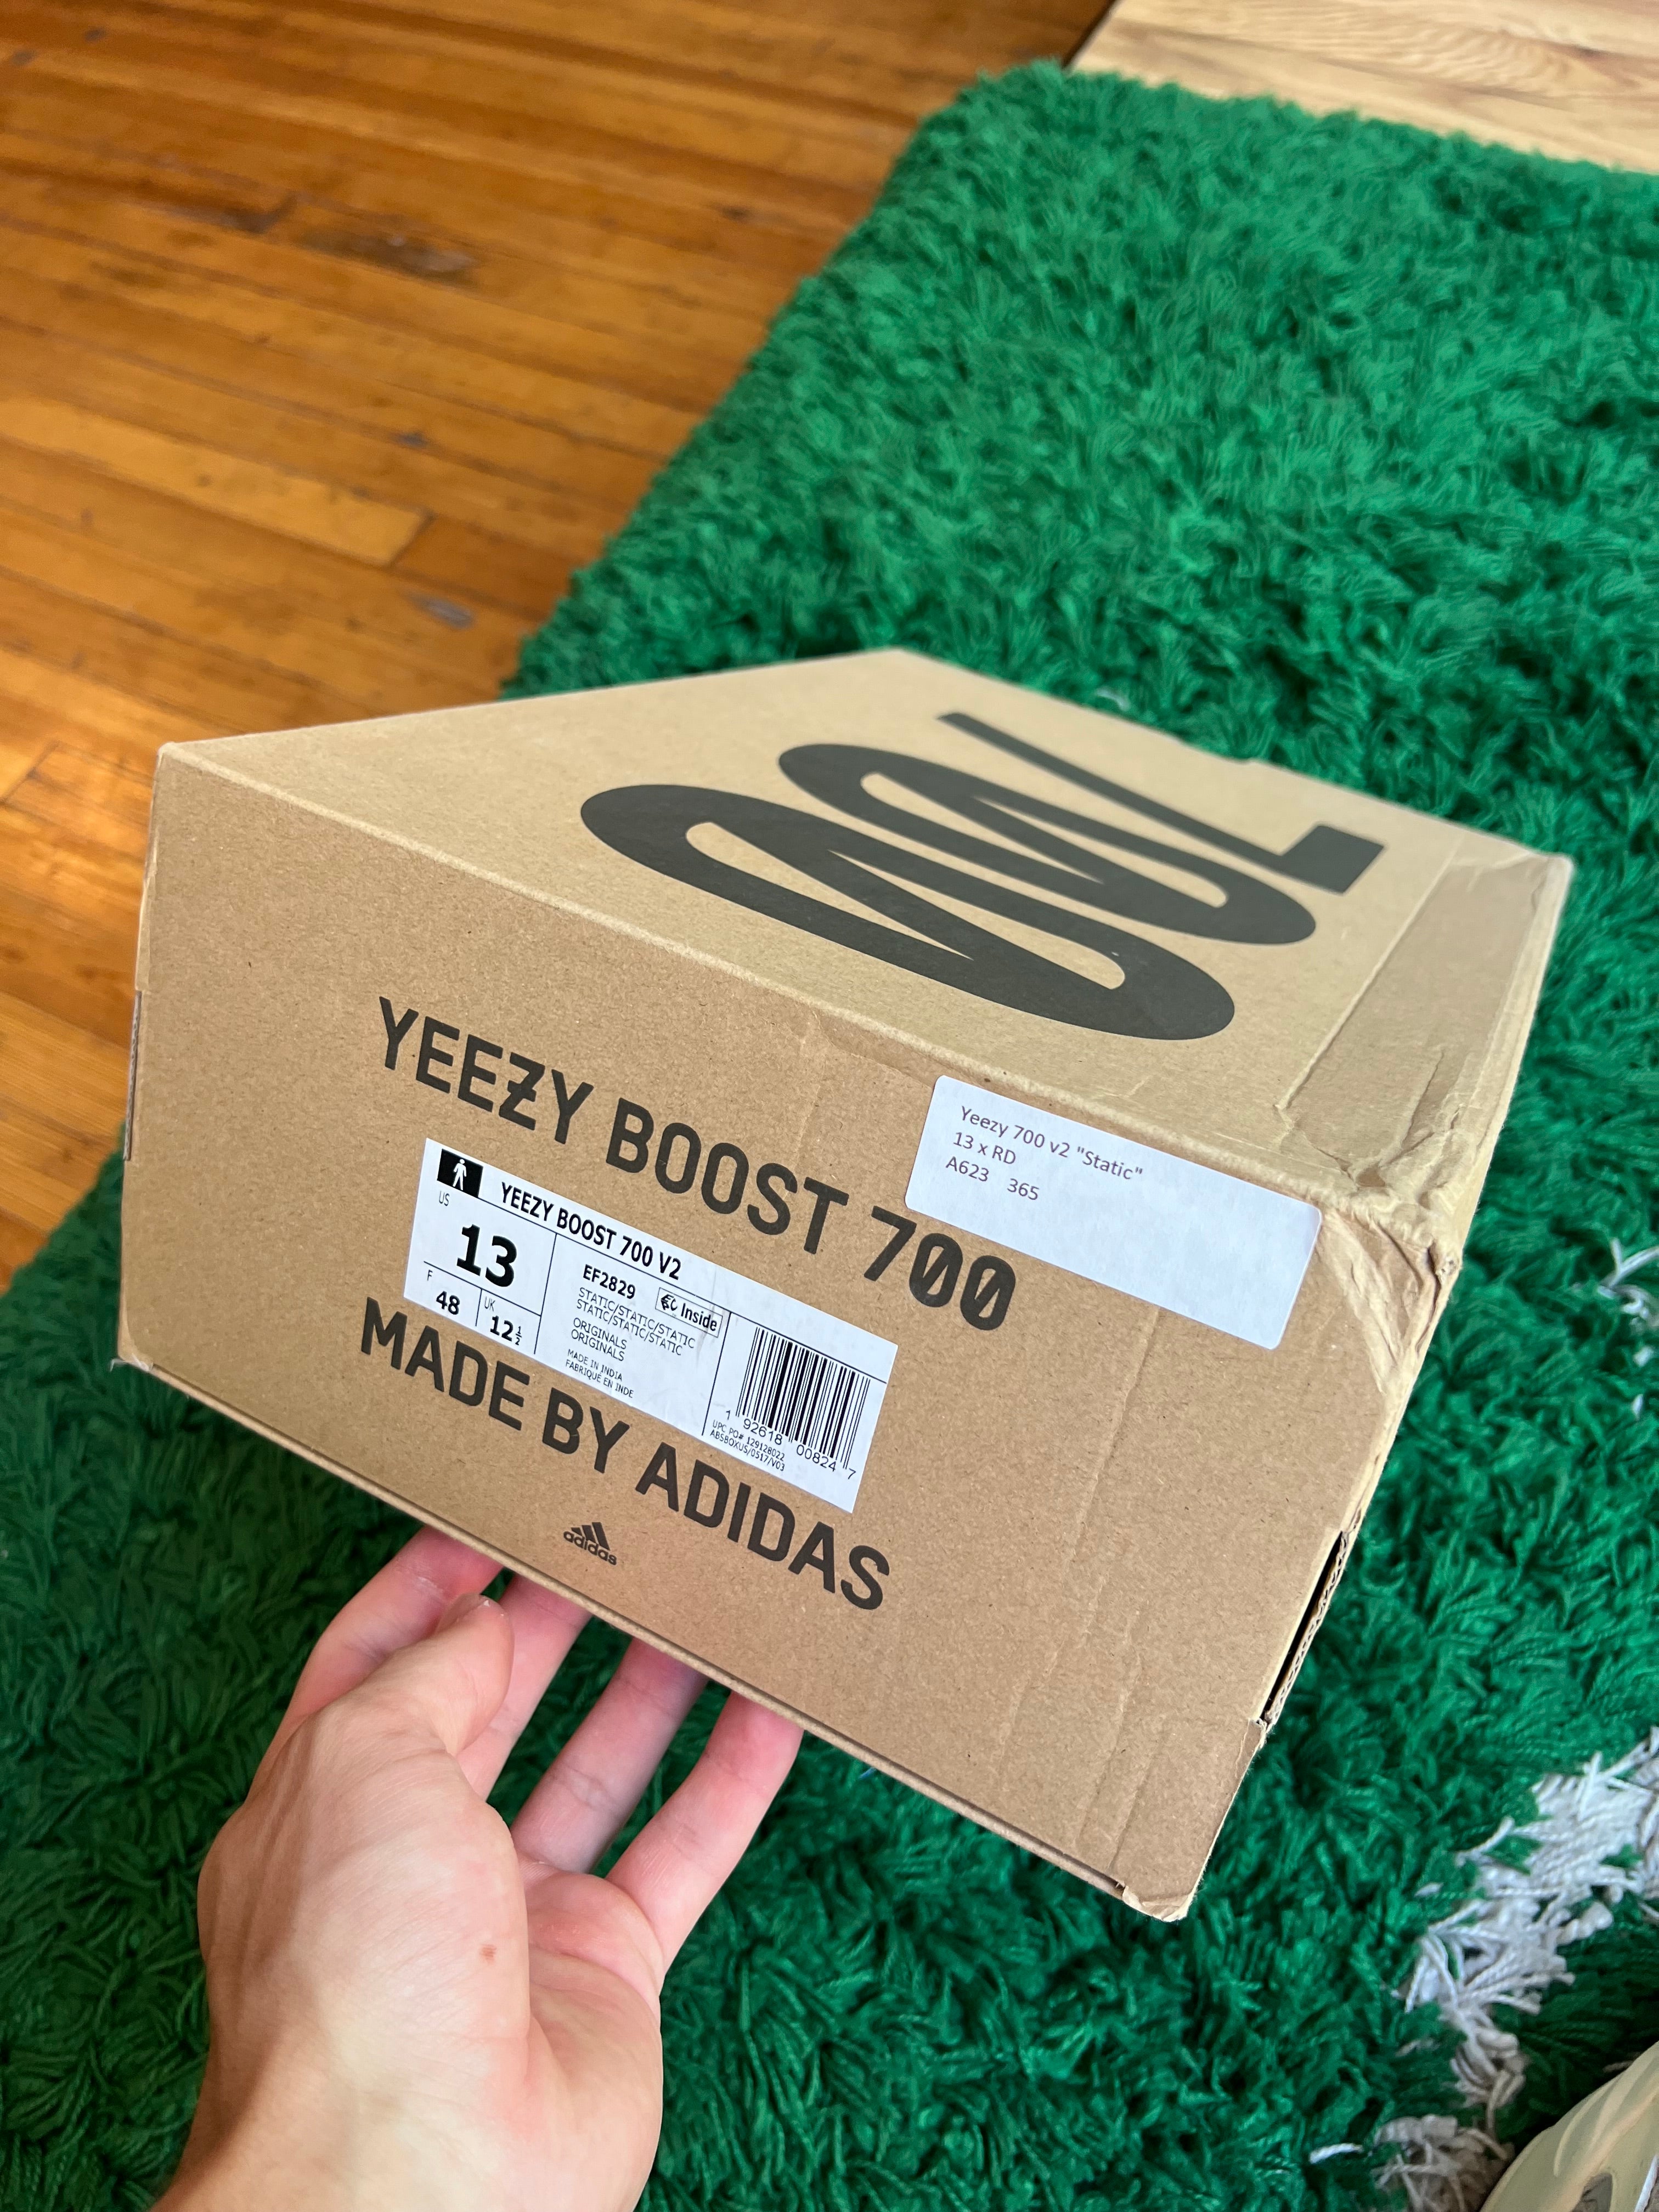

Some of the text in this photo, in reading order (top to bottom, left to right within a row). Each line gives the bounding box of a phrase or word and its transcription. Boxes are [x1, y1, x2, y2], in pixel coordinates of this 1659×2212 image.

[580, 712, 1385, 1040] 700
[952, 1131, 1017, 1165] 13 x RD
[961, 1105, 1143, 1180] Yeezy 700 v2 "Static"
[379, 996, 1016, 1331] YEEZY BOOST 700
[945, 1156, 1040, 1201] A623 365
[438, 1190, 450, 1207] US
[501, 1182, 682, 1280] YEEZY BOOST 700 V2
[456, 1224, 517, 1288] 13
[427, 1269, 433, 1282] F
[583, 1263, 636, 1299] EF2829
[436, 1290, 460, 1316] 48
[484, 1297, 495, 1312] UK
[579, 1287, 696, 1348] STATIC/STATIC/STATIC
[680, 1302, 718, 1331] Inside
[571, 1329, 625, 1362] ORIGINALS
[573, 1317, 627, 1350] ORIGINALS
[577, 1299, 683, 1356] STATIC/STATIC/STATIC
[568, 1348, 623, 1381] MADE IN INDIA
[603, 1377, 613, 1388] EN
[615, 1383, 634, 1398] INDE
[360, 1296, 890, 1610] MADE BY ADIDAS
[713, 1419, 786, 1462] UPC PO# 129128022
[725, 1409, 856, 1480] 1 92618 00824 7
[563, 1530, 617, 1566] adidas
